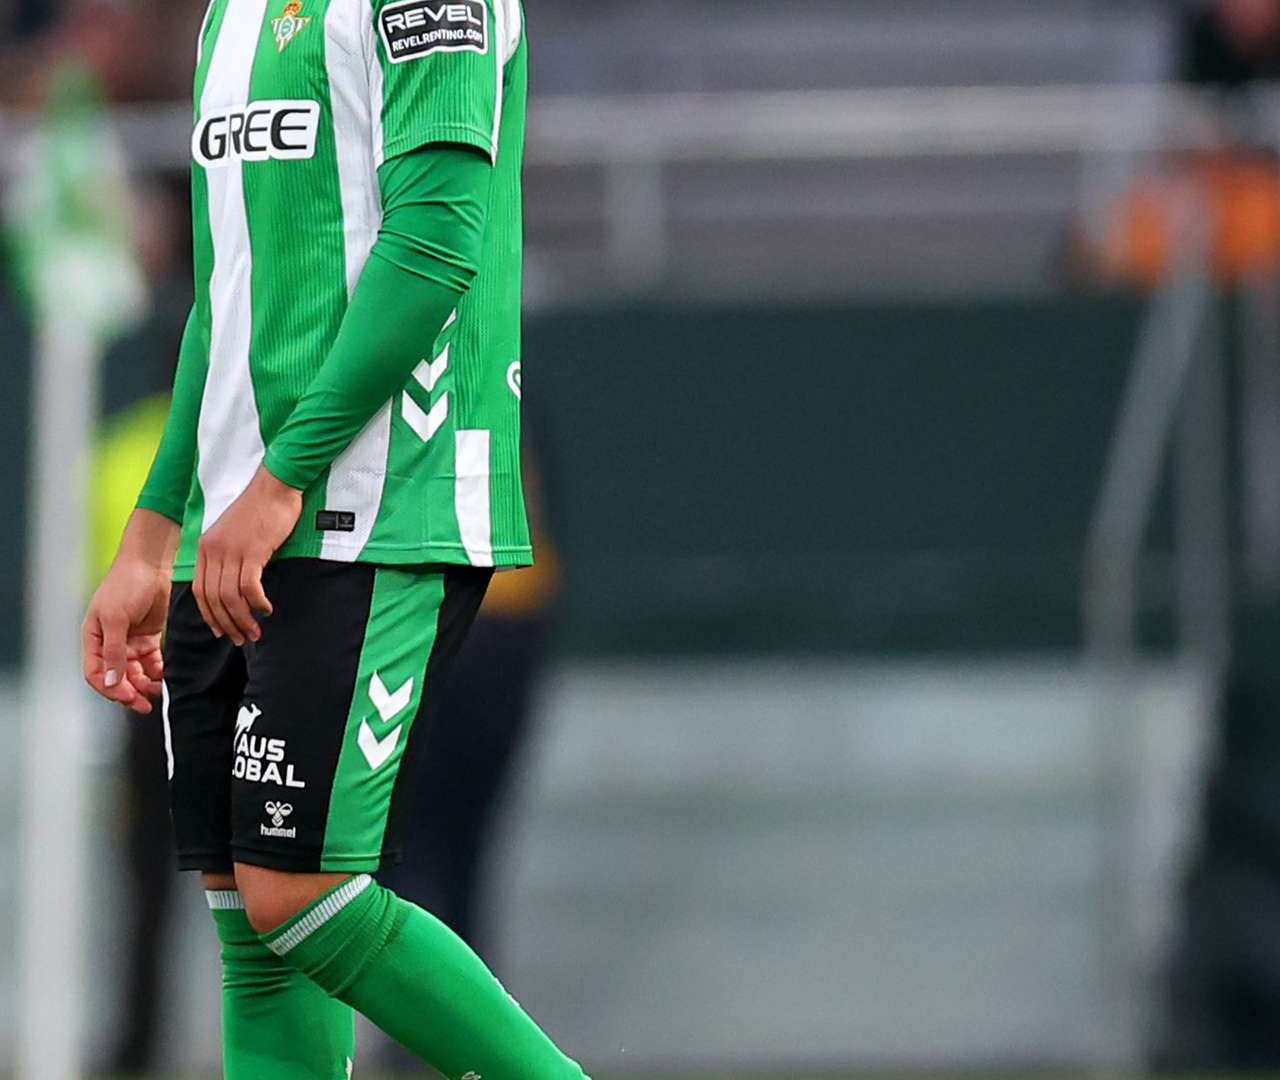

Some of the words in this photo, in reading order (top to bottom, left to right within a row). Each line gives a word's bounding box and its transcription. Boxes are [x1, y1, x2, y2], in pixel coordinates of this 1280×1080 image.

[385, 4, 482, 34] REVEL
[199, 108, 311, 161] GREE
[237, 732, 286, 762] AUS
[231, 755, 305, 788] OBAL
